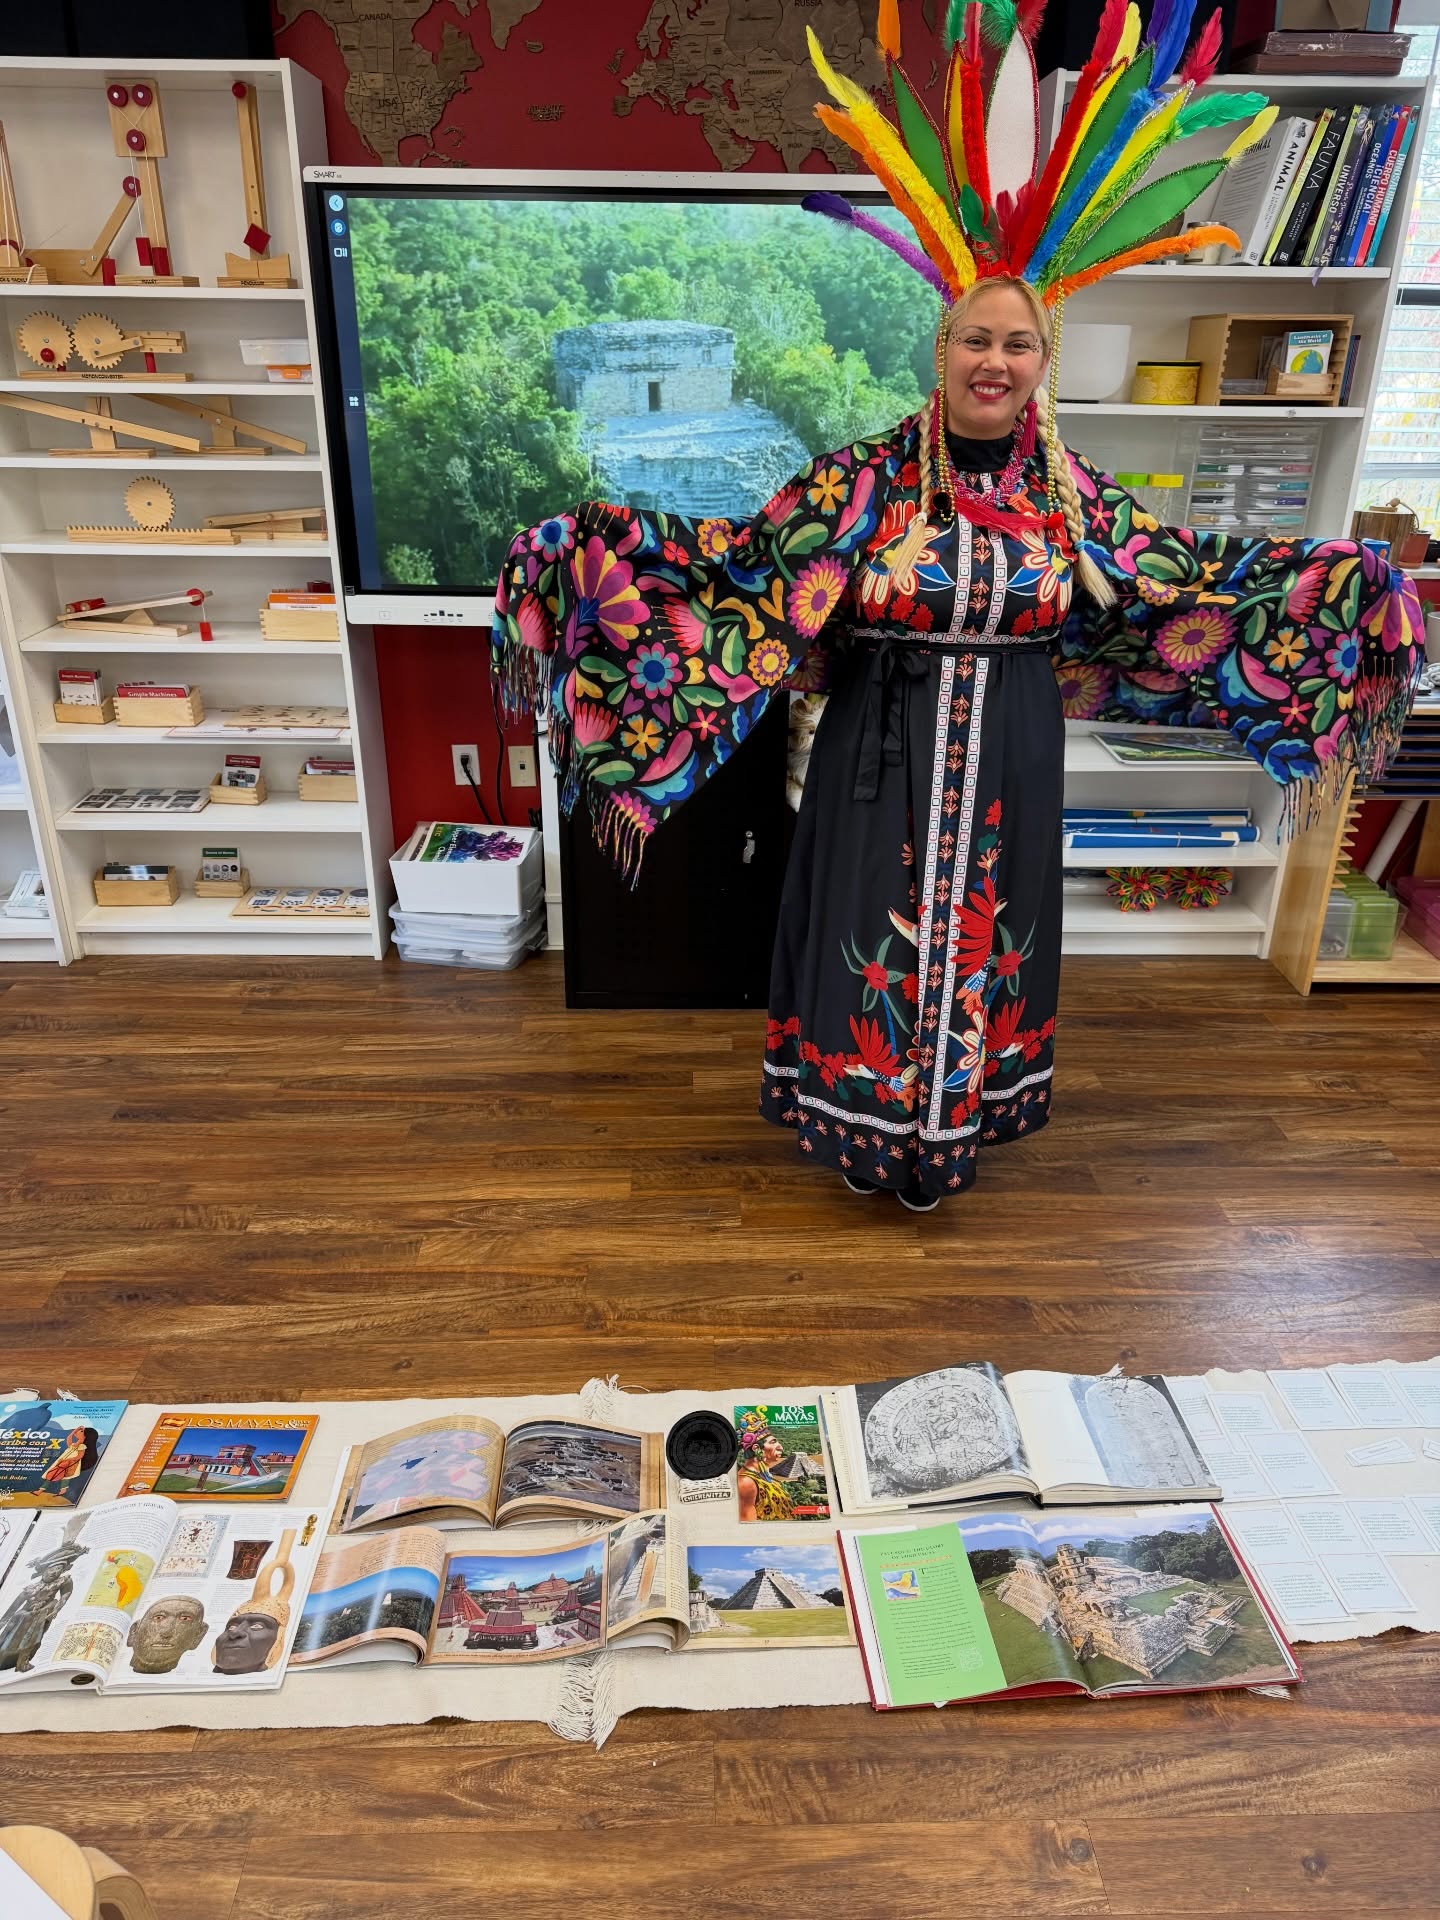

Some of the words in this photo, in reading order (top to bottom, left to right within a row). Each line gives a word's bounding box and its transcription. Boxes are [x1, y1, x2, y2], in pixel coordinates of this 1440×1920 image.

[358, 13, 392, 21] CANADA
[378, 99, 398, 108] USA
[1274, 142, 1299, 192] ANIMAL
[1306, 131, 1341, 190] FAUNA
[313, 170, 336, 178] SMART
[1380, 150, 1397, 186] CUERPO
[1329, 165, 1351, 213] UNIVERSO
[1362, 164, 1382, 213] ¡CIENCIA!
[1369, 185, 1386, 226] HUMANO
[452, 827, 462, 843] Upper
[781, 1405, 804, 1413] LOS
[186, 1418, 223, 1427] LOS
[225, 1418, 285, 1428] MAYAS
[774, 1412, 814, 1421] MAYAS
[46, 1438, 65, 1449] X
